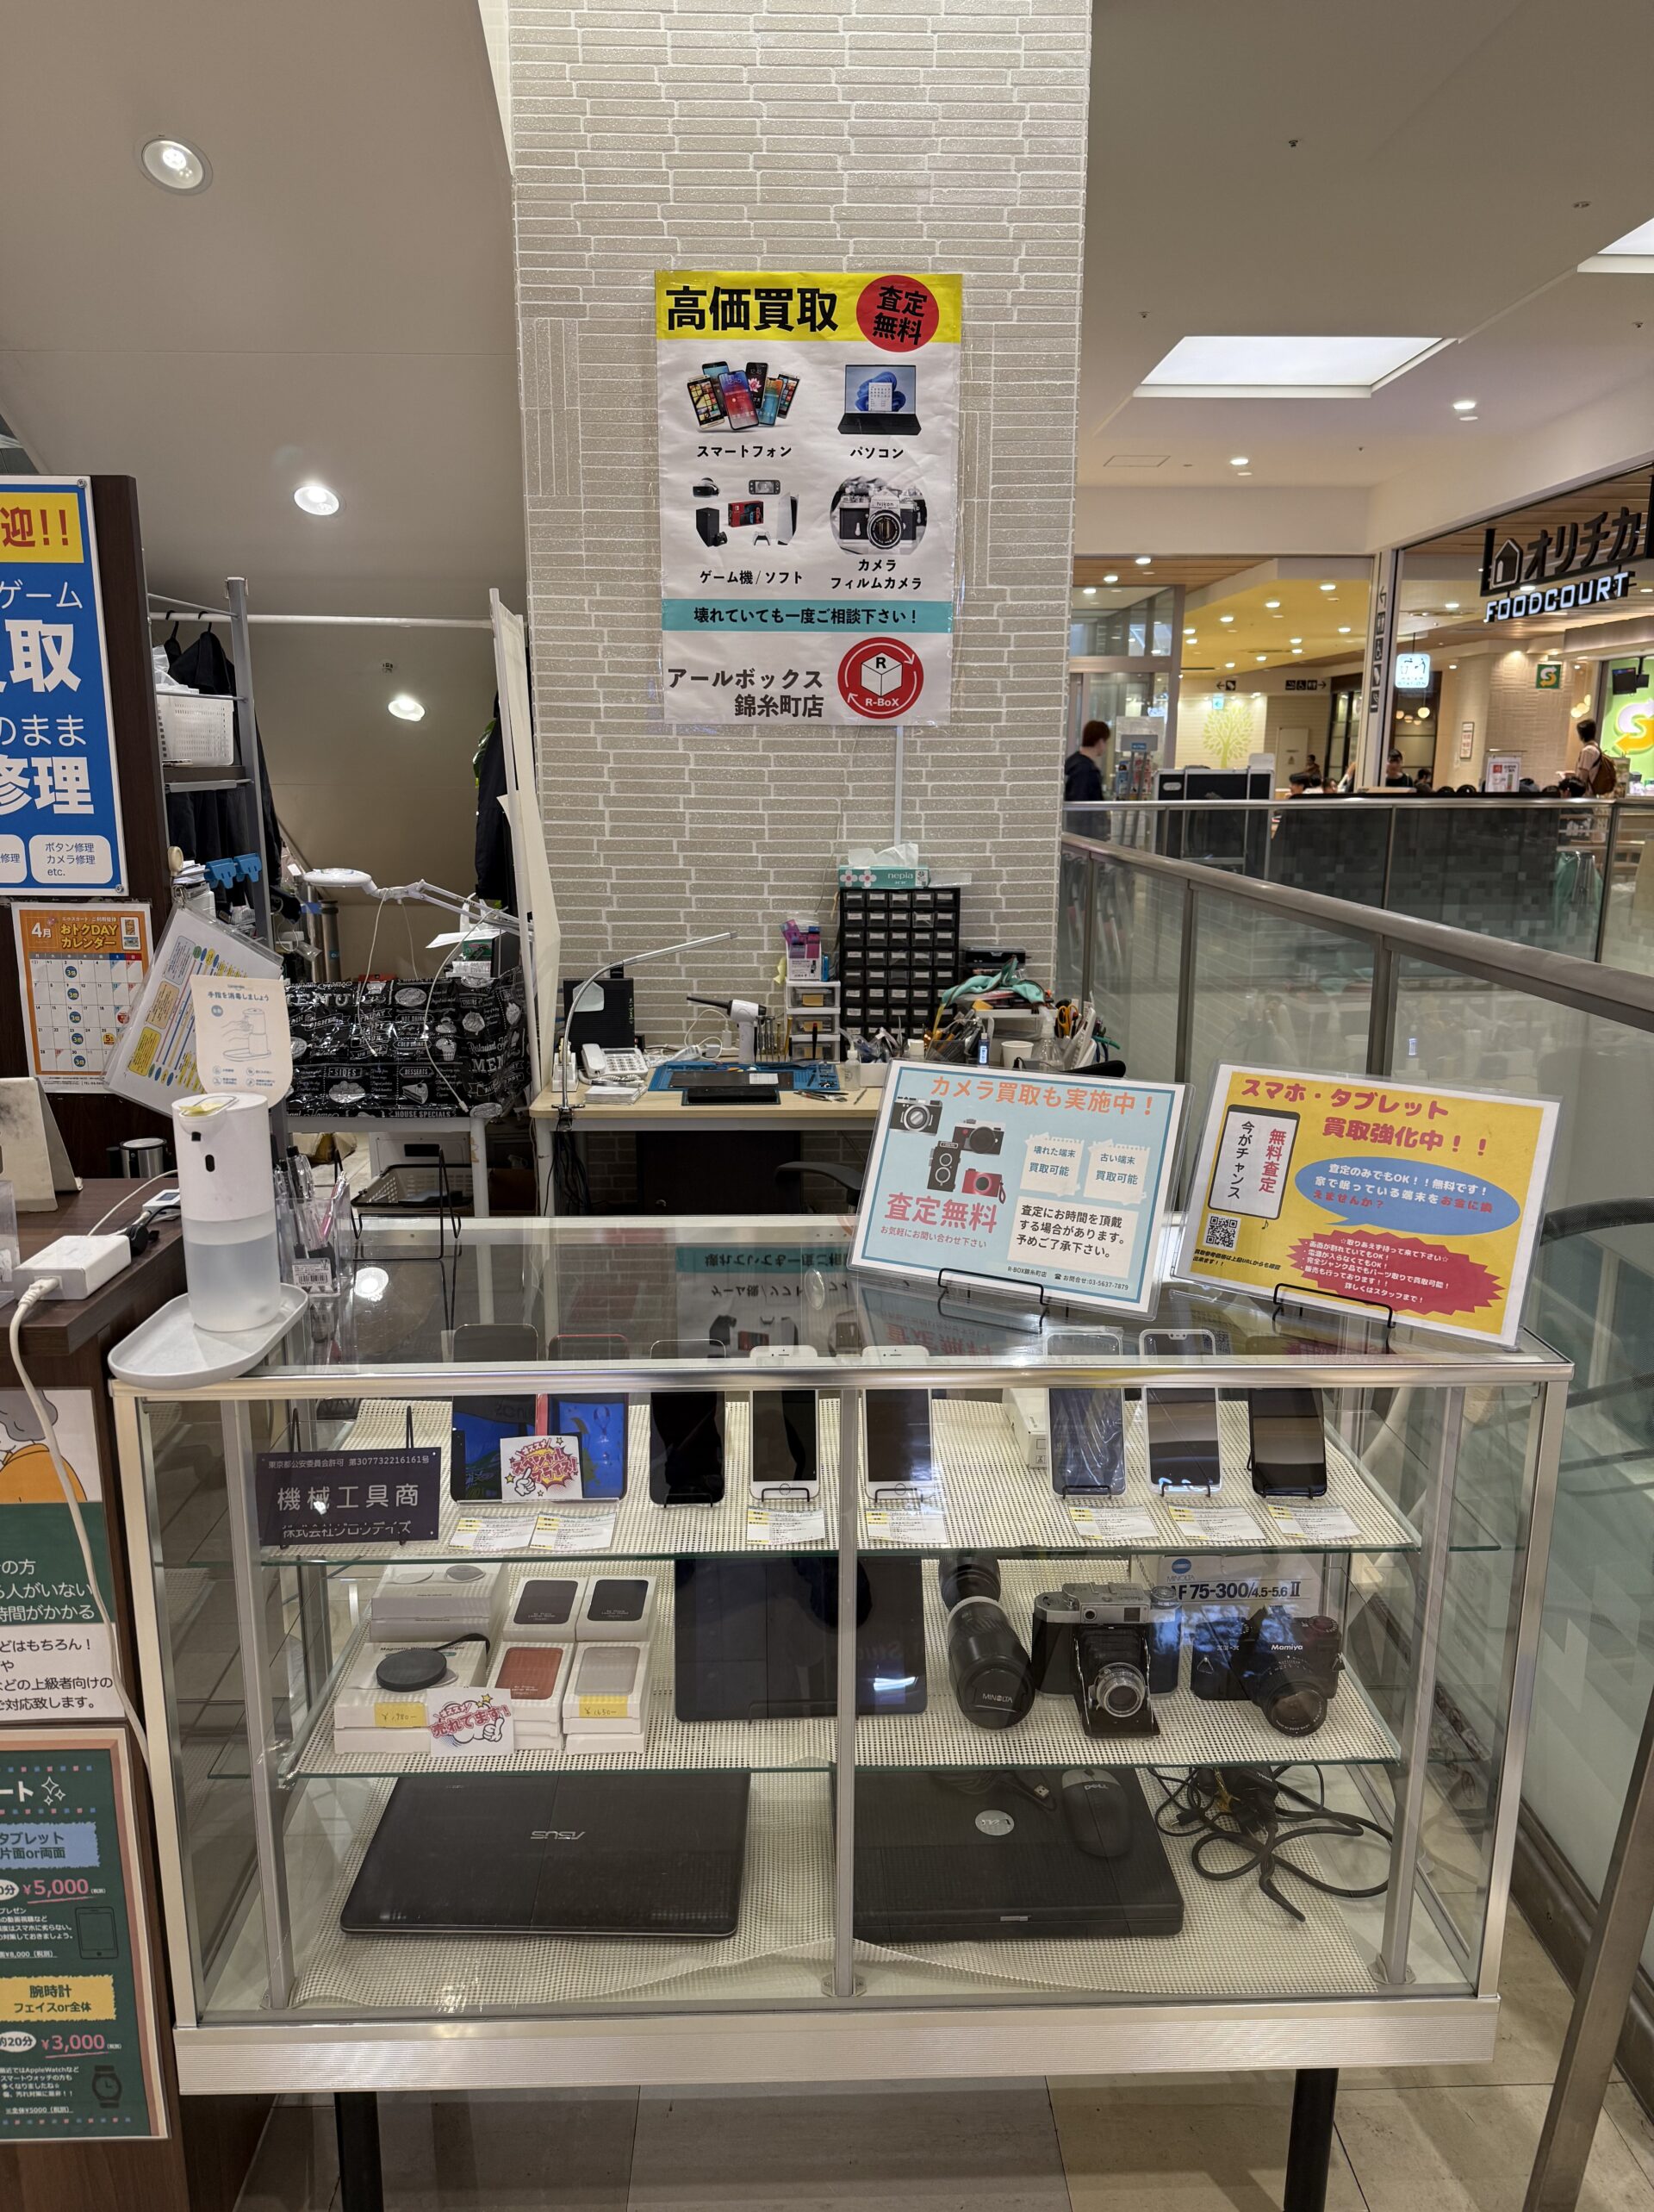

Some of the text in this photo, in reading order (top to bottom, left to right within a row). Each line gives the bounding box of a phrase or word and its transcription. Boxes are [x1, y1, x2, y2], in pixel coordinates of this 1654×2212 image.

[666, 285, 839, 332] 高価買取
[876, 284, 928, 318] 査定
[873, 313, 922, 346] 無料
[696, 446, 792, 458] スマートフォン
[850, 447, 904, 459] パソコン
[1524, 507, 1642, 579] オリチカ
[858, 559, 897, 572] カメラ
[830, 576, 923, 590] フィルムカメラ
[0, 579, 84, 609] ゲーム
[1485, 571, 1632, 622] FOODCOURT
[693, 608, 917, 625] 壊れていても一度ご相談下さい！
[875, 657, 886, 669] R
[668, 668, 824, 689] アールボックス
[734, 695, 824, 718] 錦糸町店
[45, 843, 95, 853] ボタン修理
[47, 855, 96, 865] カメラ修理
[47, 868, 65, 876] etc.
[60, 924, 117, 936] おトクDAY
[61, 937, 116, 949] カレンダー
[930, 1076, 1153, 1116] カメラ買取も実施中！
[1240, 1079, 1448, 1119] スマホ・タブレット
[1034, 1145, 1076, 1158] 壊れた端末
[1100, 1153, 1135, 1165] 古い端末
[1228, 1121, 1255, 1199] 今がチャンス
[1259, 1129, 1286, 1193] 無料査定
[1029, 1162, 1070, 1177] 買取可能
[1096, 1169, 1138, 1185] 買取可能
[885, 1192, 998, 1233] 査定無料
[1021, 1205, 1122, 1228] 査定にお時間を頂戴
[880, 1225, 986, 1248] お気軽にお問い合わせ下さい
[1020, 1219, 1124, 1244] する場合があります。
[1017, 1234, 1110, 1258] 予めご了承下さい。
[268, 1459, 344, 1468] 東京都公安委員会許可
[277, 1483, 419, 1511] 機械工具商
[982, 1692, 1014, 1704] MINOLTA
[1084, 1783, 1109, 1791] DELL
[29, 1985, 72, 1998] 腕時計
[14, 2002, 91, 2013] フェイスor全体
